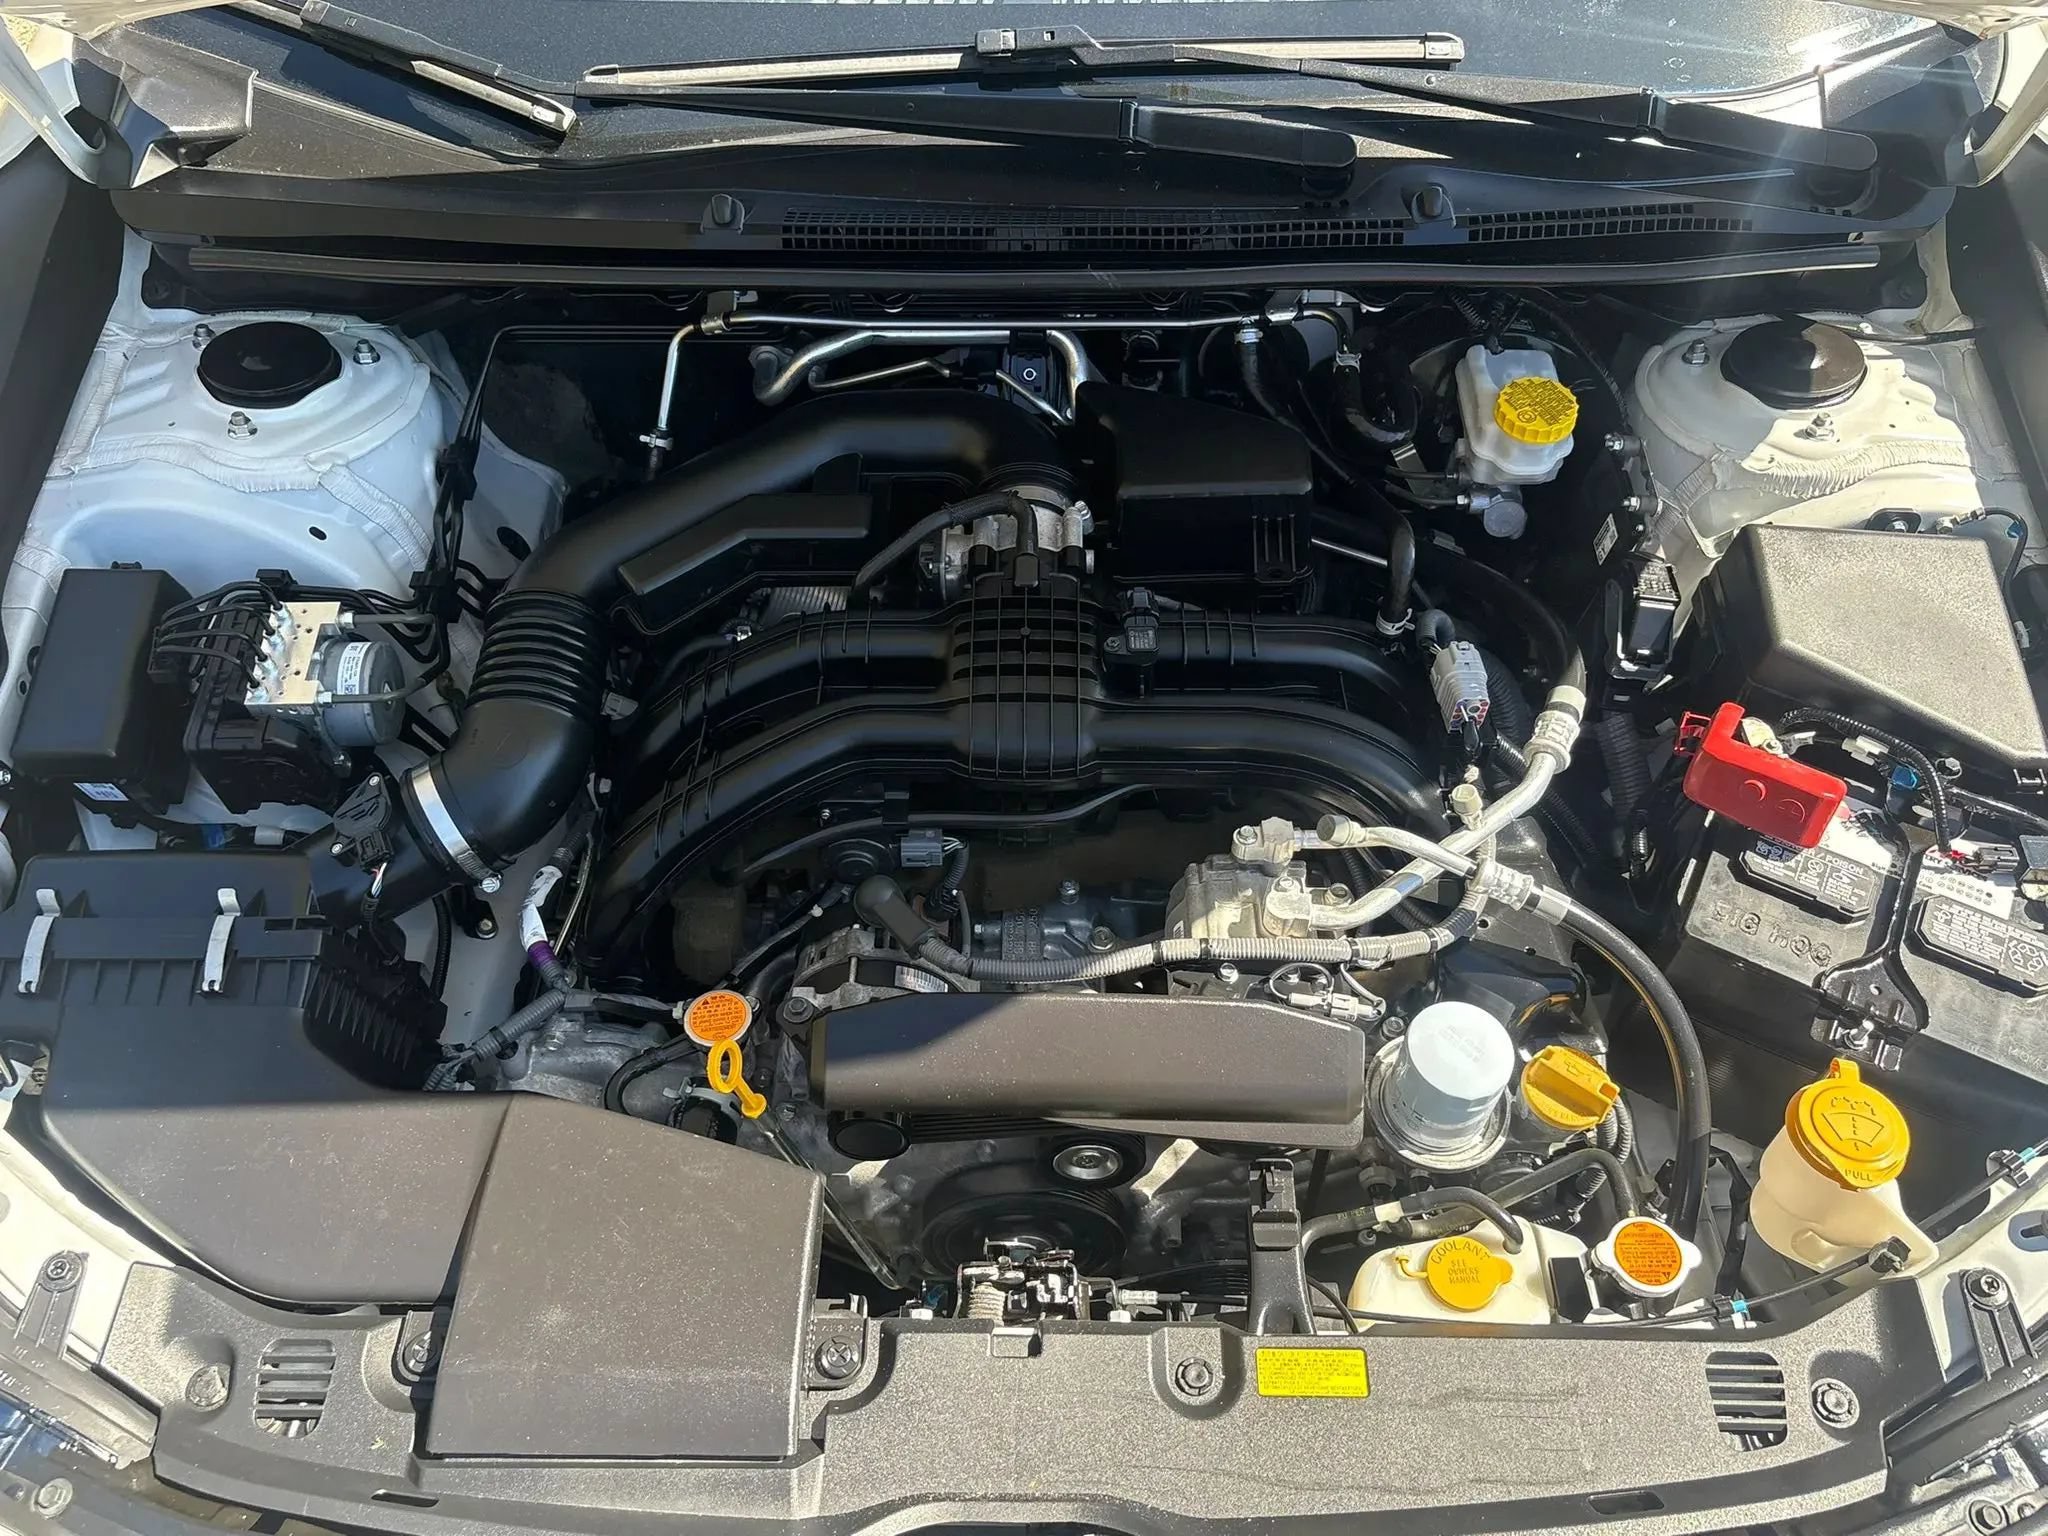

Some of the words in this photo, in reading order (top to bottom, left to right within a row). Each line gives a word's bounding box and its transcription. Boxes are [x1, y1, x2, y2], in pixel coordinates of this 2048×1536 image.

[1825, 854, 1864, 875] POISON
[1768, 922, 1833, 967] HOG
[1844, 1168, 1873, 1182] PULL
[1430, 1239, 1491, 1265] COOLANT
[1448, 1275, 1481, 1284] MANUAL
